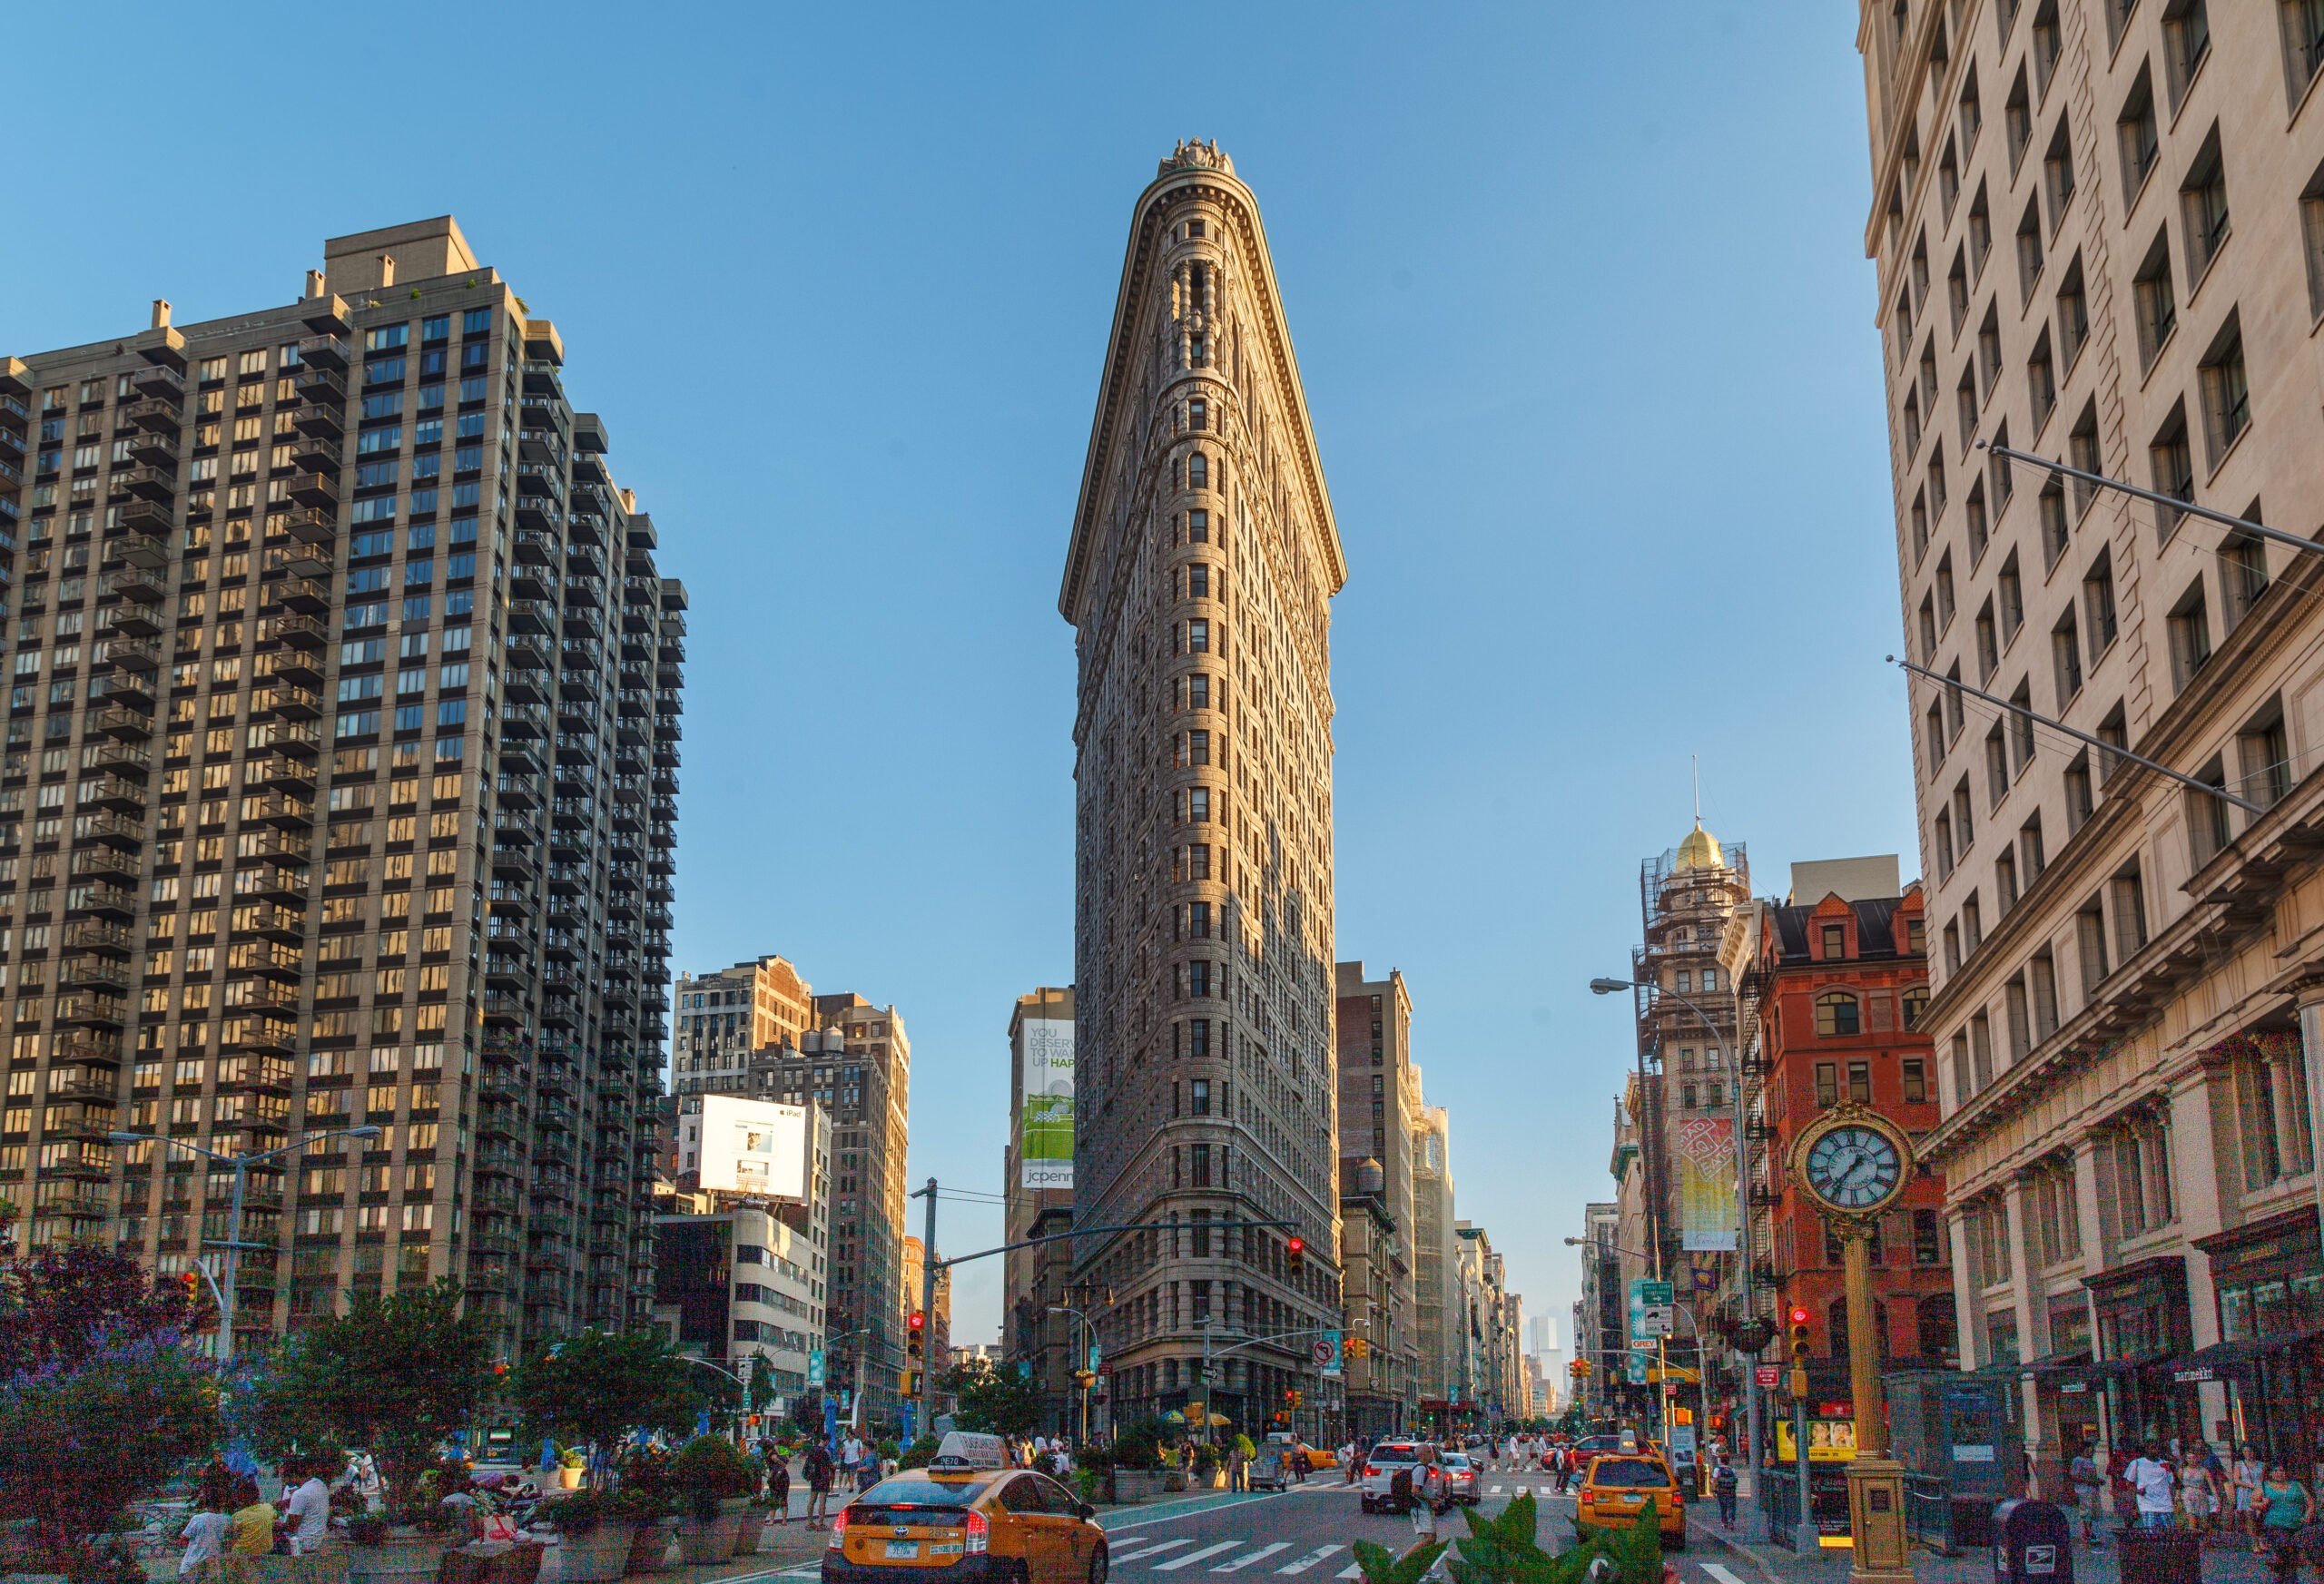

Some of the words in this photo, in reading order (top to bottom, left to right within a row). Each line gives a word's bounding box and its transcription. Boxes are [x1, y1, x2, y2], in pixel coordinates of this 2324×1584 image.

[1031, 1028, 1058, 1038] YOU
[1030, 1048, 1047, 1058] TO
[1032, 1058, 1048, 1067] UP
[1050, 1058, 1075, 1068] HAP
[786, 1109, 802, 1118] iPad
[1633, 1340, 1655, 1348] GREY
